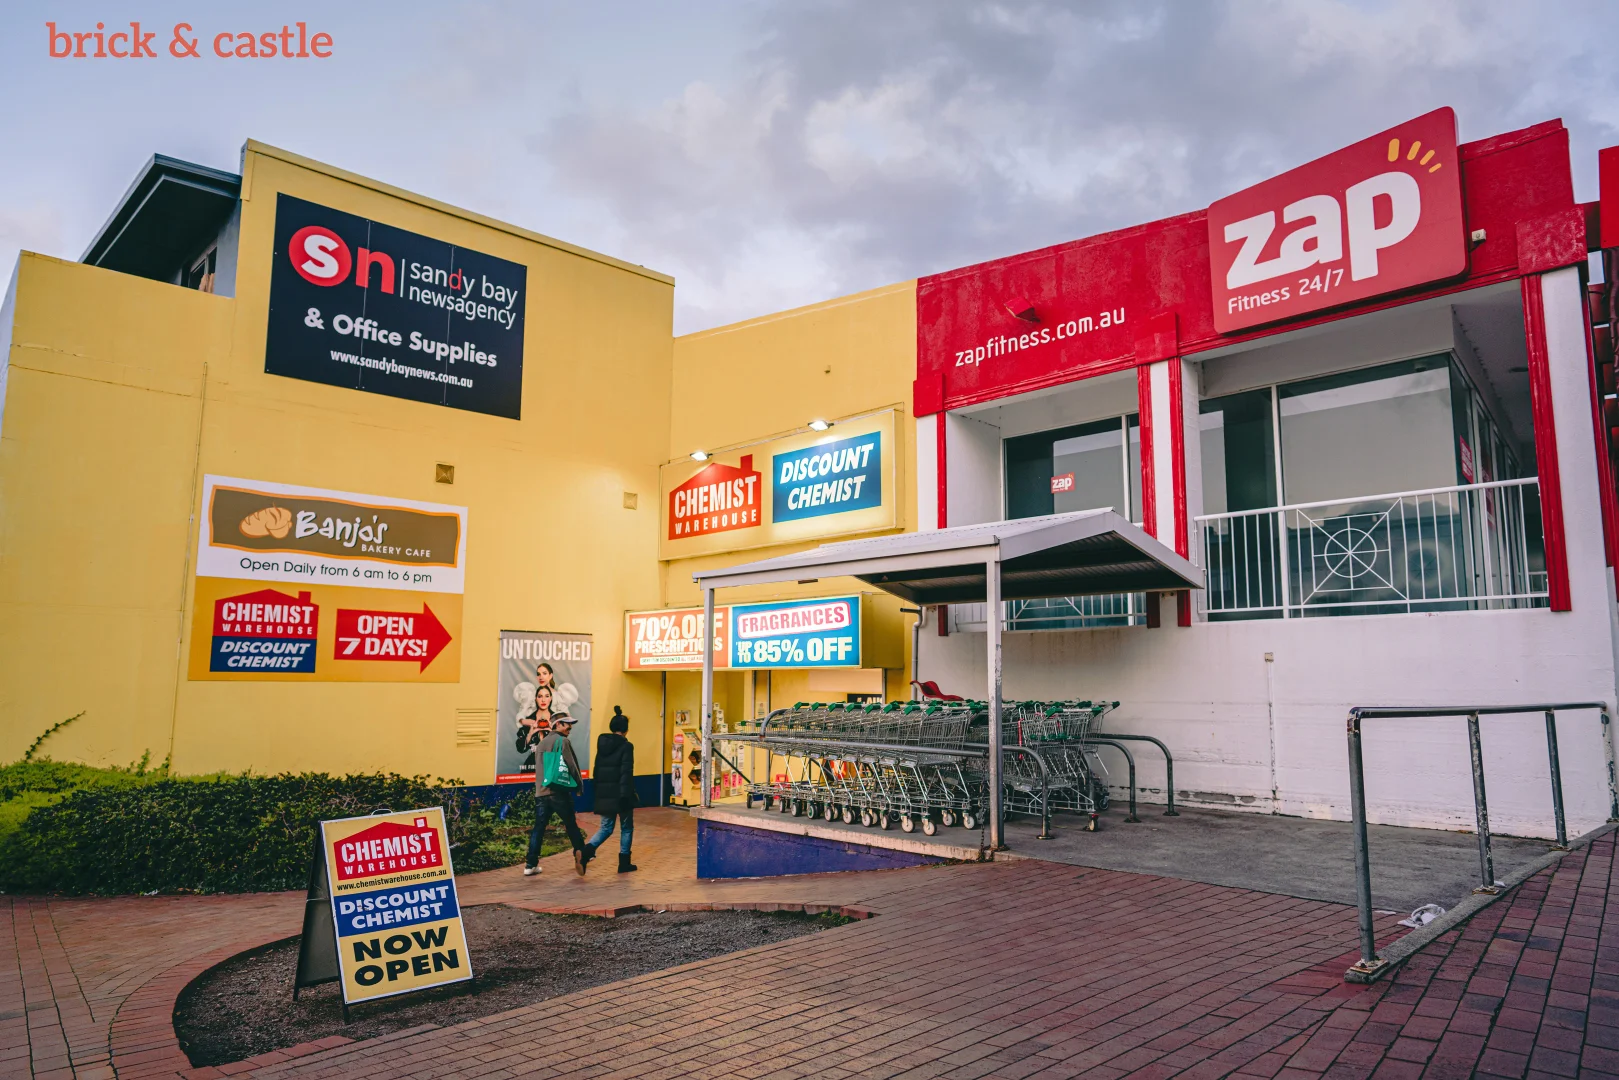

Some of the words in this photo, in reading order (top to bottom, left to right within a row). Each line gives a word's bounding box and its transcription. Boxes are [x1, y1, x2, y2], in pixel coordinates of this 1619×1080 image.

[1224, 171, 1421, 290] zap
[410, 262, 475, 298] sandy
[481, 275, 518, 309] bay
[1228, 286, 1290, 314] Fitness
[1299, 268, 1344, 296] 24/7
[409, 284, 516, 330] newsagency
[304, 307, 325, 330] &
[333, 314, 402, 346] Office
[409, 331, 497, 367] Supplies
[955, 307, 1125, 367] zapfitness.com.au
[330, 350, 473, 388] www.sandybaynews.com.au
[780, 443, 874, 484] DISCOUNT
[675, 475, 757, 519] CHEMIST
[787, 475, 866, 511] CHEMIST
[1052, 478, 1072, 490] zap
[295, 511, 388, 548] Banjo's
[675, 509, 757, 535] WAREHOUSE
[361, 544, 401, 555] BAKERY
[405, 548, 431, 558] CAFE
[240, 558, 279, 573] Open
[284, 561, 316, 576] Daily
[320, 564, 348, 577] from
[352, 566, 360, 578] 6
[364, 570, 384, 580] am
[388, 569, 399, 581] to
[402, 569, 410, 581] 6
[413, 572, 432, 584] pm
[222, 602, 313, 624] CHEMIST
[357, 615, 414, 636] OPEN
[742, 606, 844, 633] FRAGRANCES
[222, 623, 313, 635] WAREHOUSE
[632, 615, 680, 641] 70%
[220, 641, 310, 655] DISCOUNT
[338, 637, 361, 655] 7
[364, 638, 428, 657] DAYS!
[502, 639, 591, 661] UNTOUCHED
[635, 637, 723, 654] PRESCRIPTIOS
[754, 639, 804, 662] 85%
[807, 637, 853, 661] OFF
[227, 655, 303, 668] CHEMIST
[341, 832, 433, 863] CHEMIST
[345, 853, 437, 875] WAREHOUSE
[337, 868, 447, 891] www.chemistwarehouse.com.au
[339, 886, 449, 915] DISCOUNT
[351, 902, 443, 929] CHEMIST
[353, 926, 449, 962] NOW
[354, 949, 460, 986] OPEN
